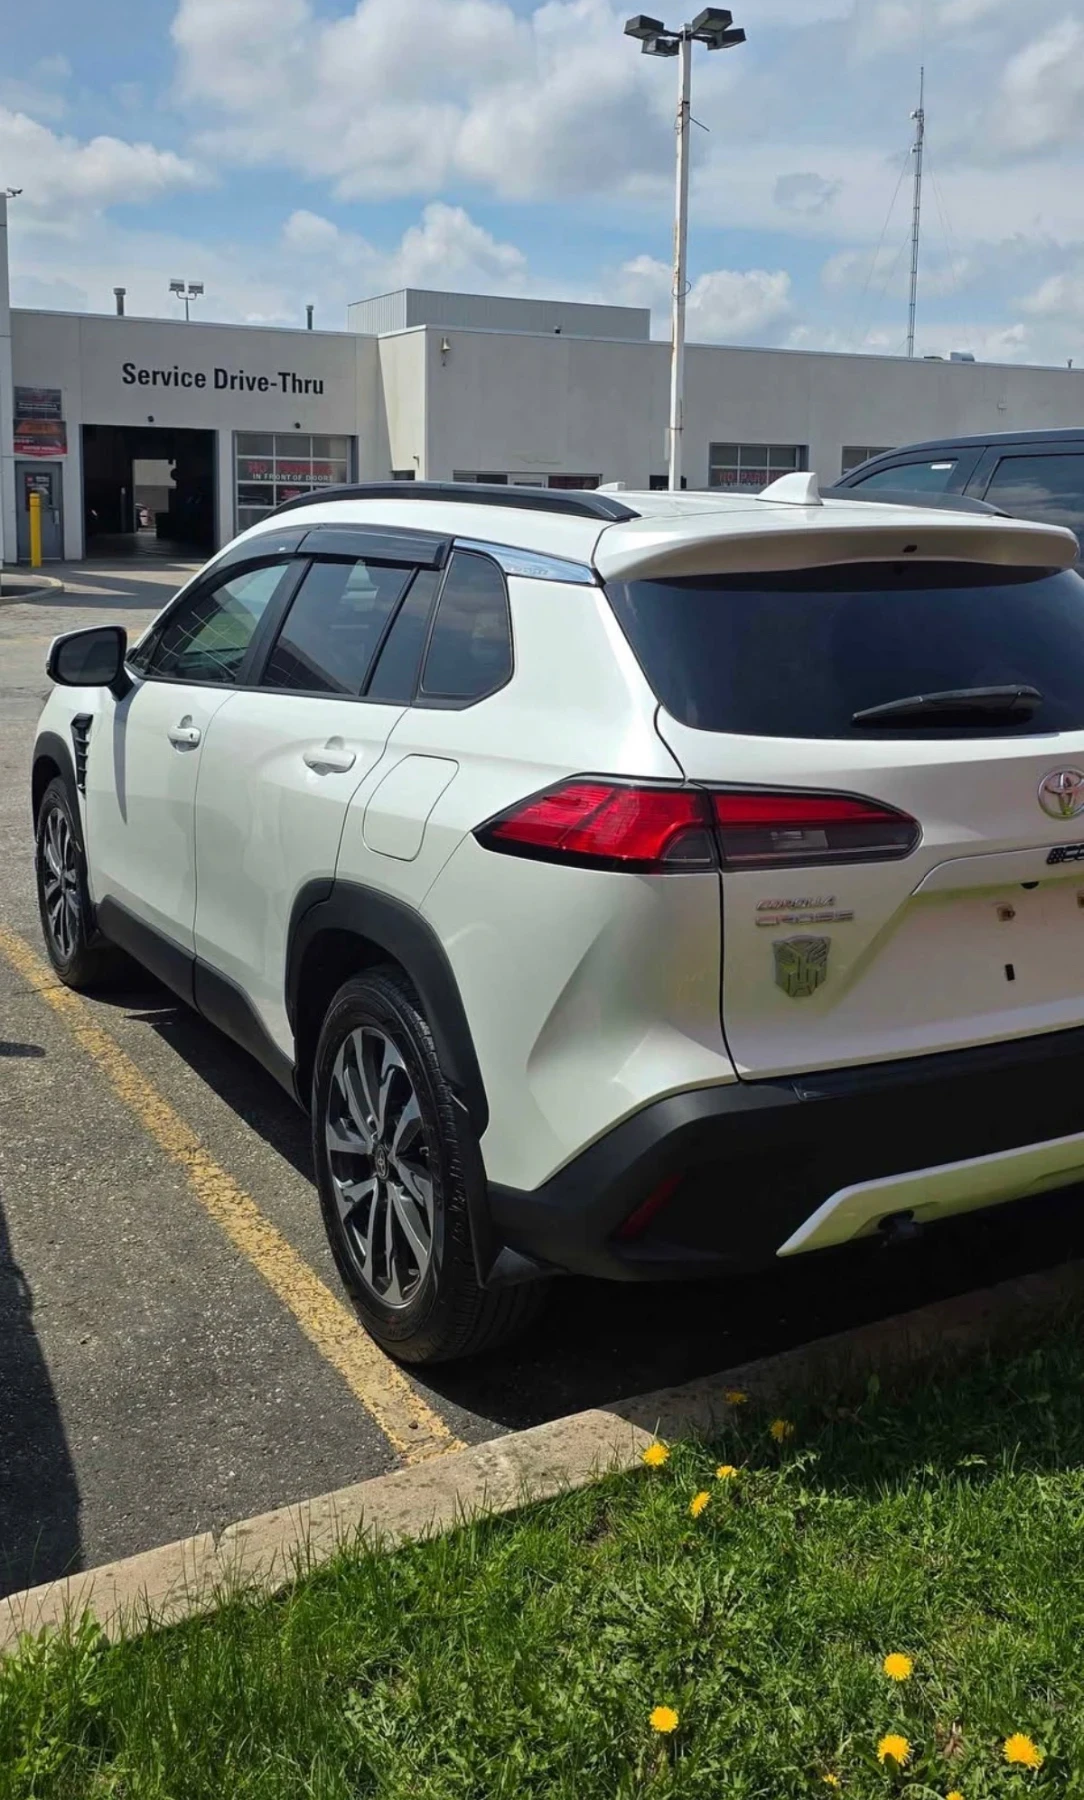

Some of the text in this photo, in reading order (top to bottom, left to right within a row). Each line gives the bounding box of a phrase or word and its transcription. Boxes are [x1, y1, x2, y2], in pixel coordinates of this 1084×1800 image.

[122, 362, 325, 395] Service Drive-Thru
[264, 473, 291, 481] FRONT
[756, 895, 837, 911] COROLLA
[755, 909, 854, 926] CROSS
